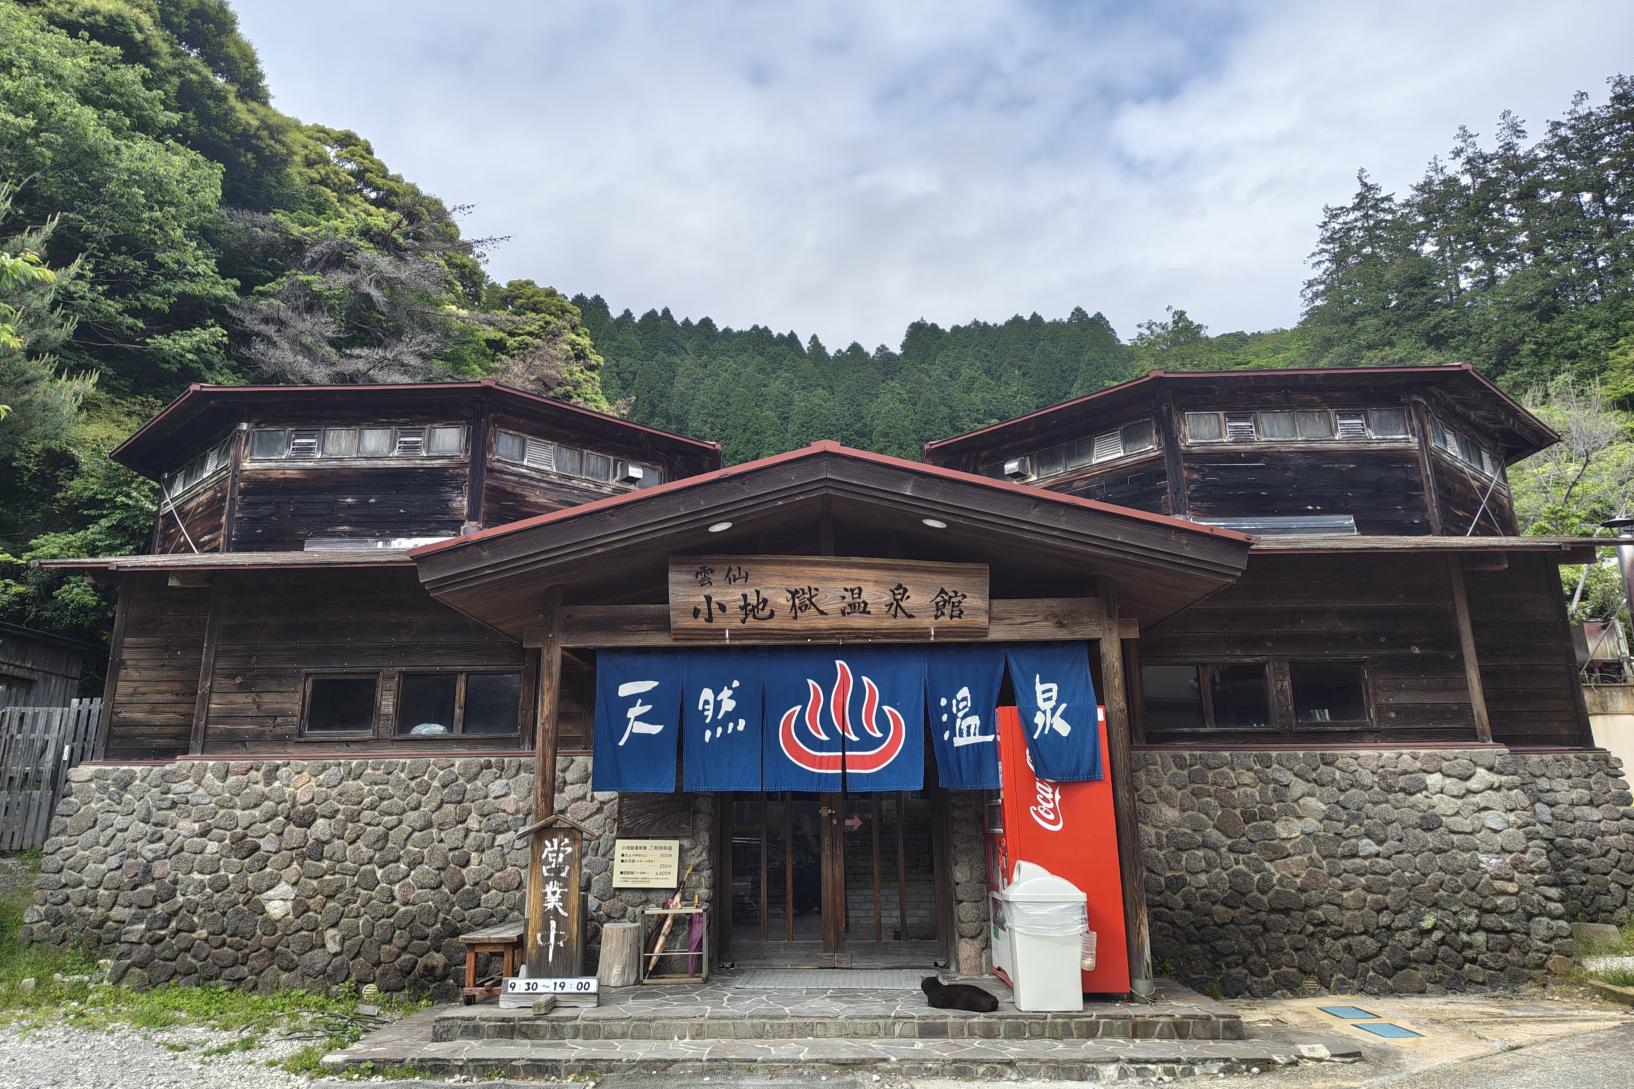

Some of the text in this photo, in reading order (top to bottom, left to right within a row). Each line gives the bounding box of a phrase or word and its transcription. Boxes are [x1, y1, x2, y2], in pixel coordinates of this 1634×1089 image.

[692, 582, 968, 625] 小地獄温泉館
[695, 565, 749, 587] 雲仙
[617, 673, 1072, 747] 天然 温泉
[536, 837, 573, 963] 営業中
